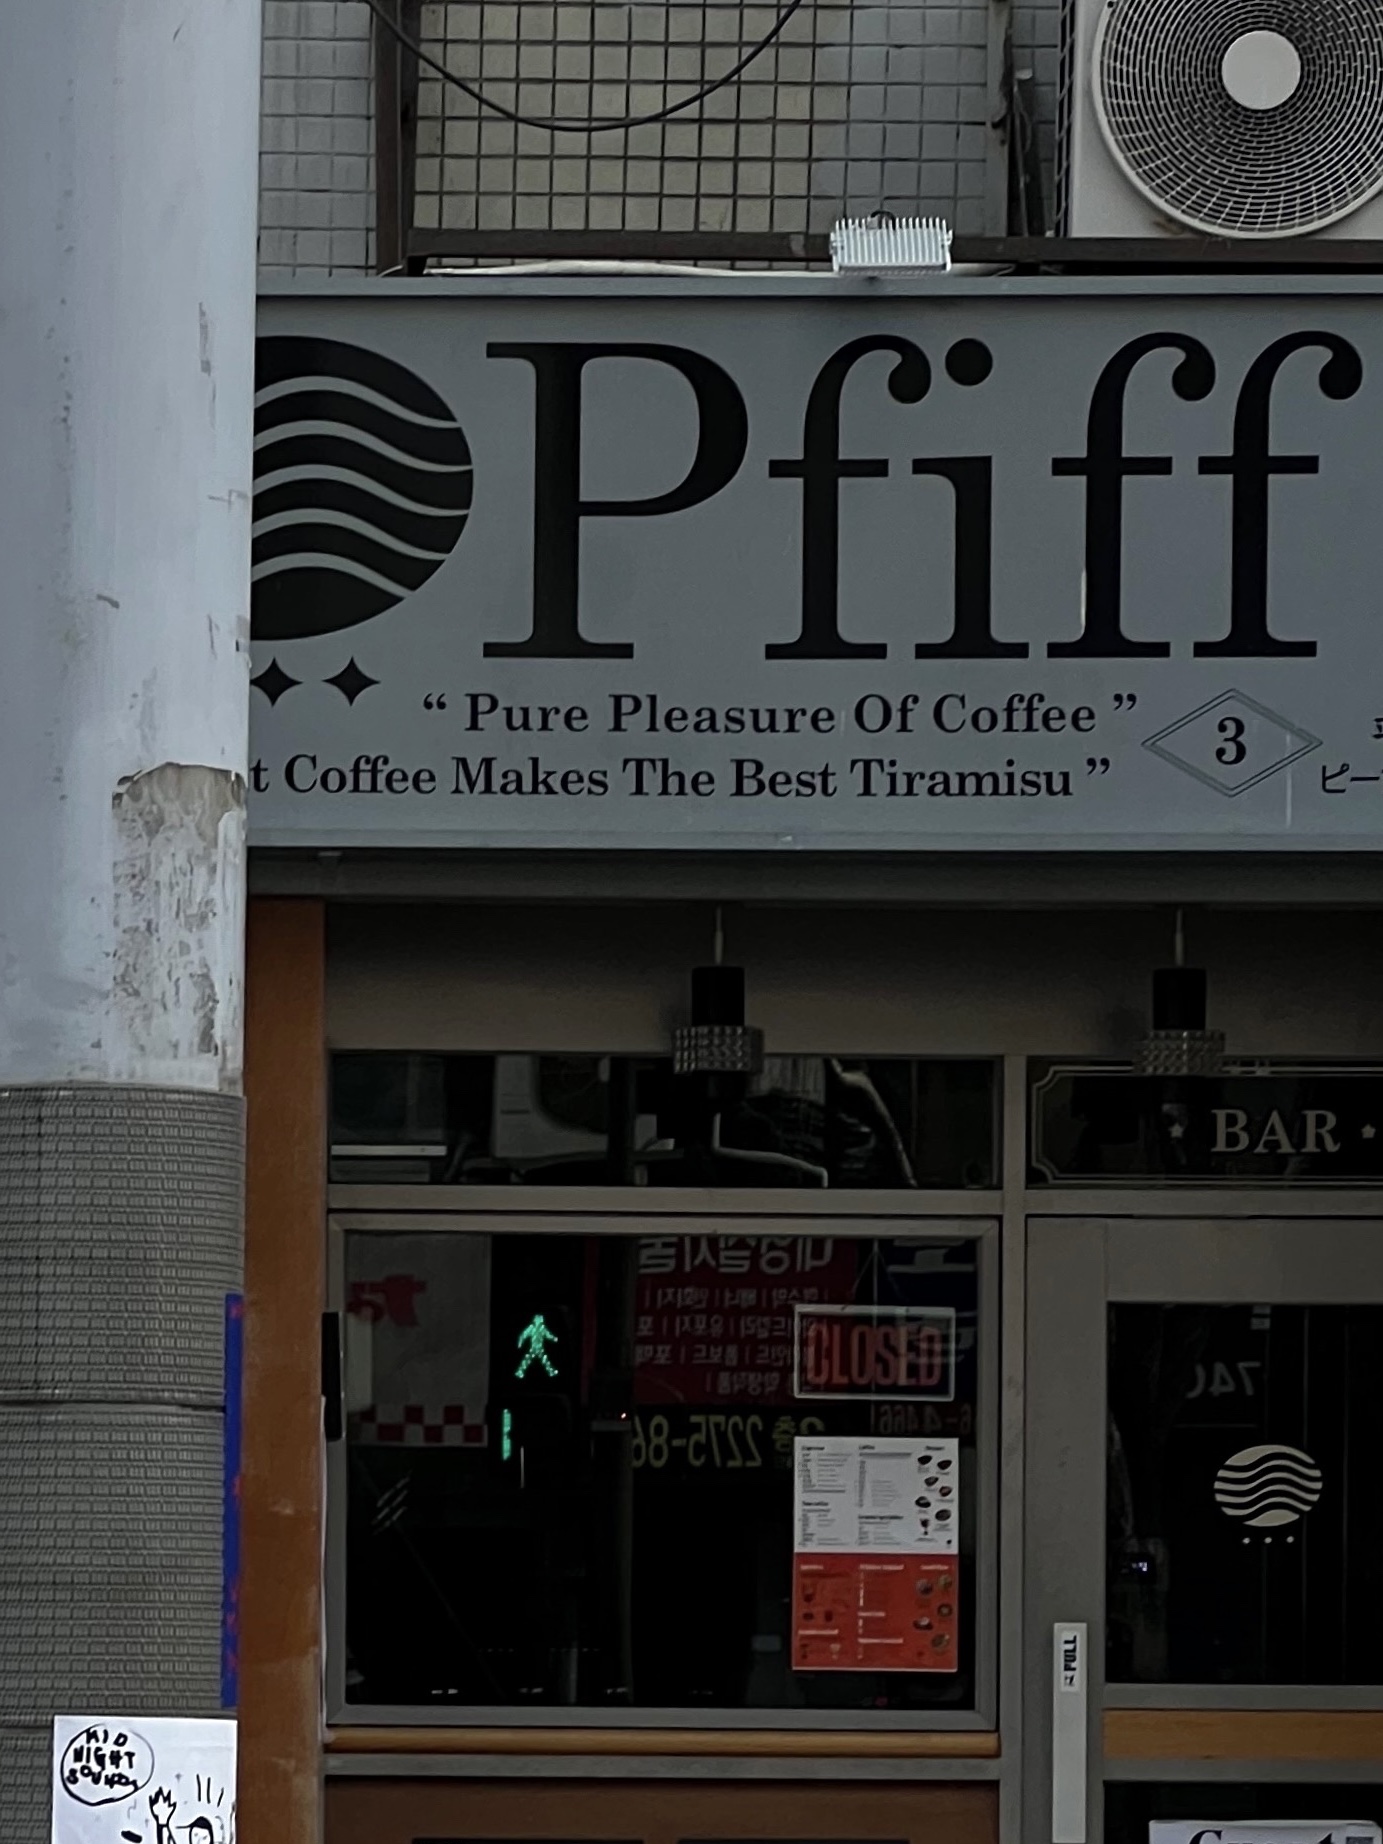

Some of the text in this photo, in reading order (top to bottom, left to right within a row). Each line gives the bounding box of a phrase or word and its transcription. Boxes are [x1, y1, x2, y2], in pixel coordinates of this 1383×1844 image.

[482, 331, 1364, 660] Pfiff
[608, 694, 835, 734] Pleasure
[854, 694, 920, 734] Of
[1215, 717, 1247, 765] 3
[284, 755, 436, 795] Coffee
[450, 756, 609, 796] Makes
[622, 757, 715, 797] The
[729, 758, 838, 798] Best
[1321, 763, 1383, 793] ピー
[1210, 1109, 1342, 1154] BAR
[806, 1323, 943, 1387] CLOSED
[1063, 1635, 1077, 1671] PULL
[73, 1745, 136, 1770] NIGHT
